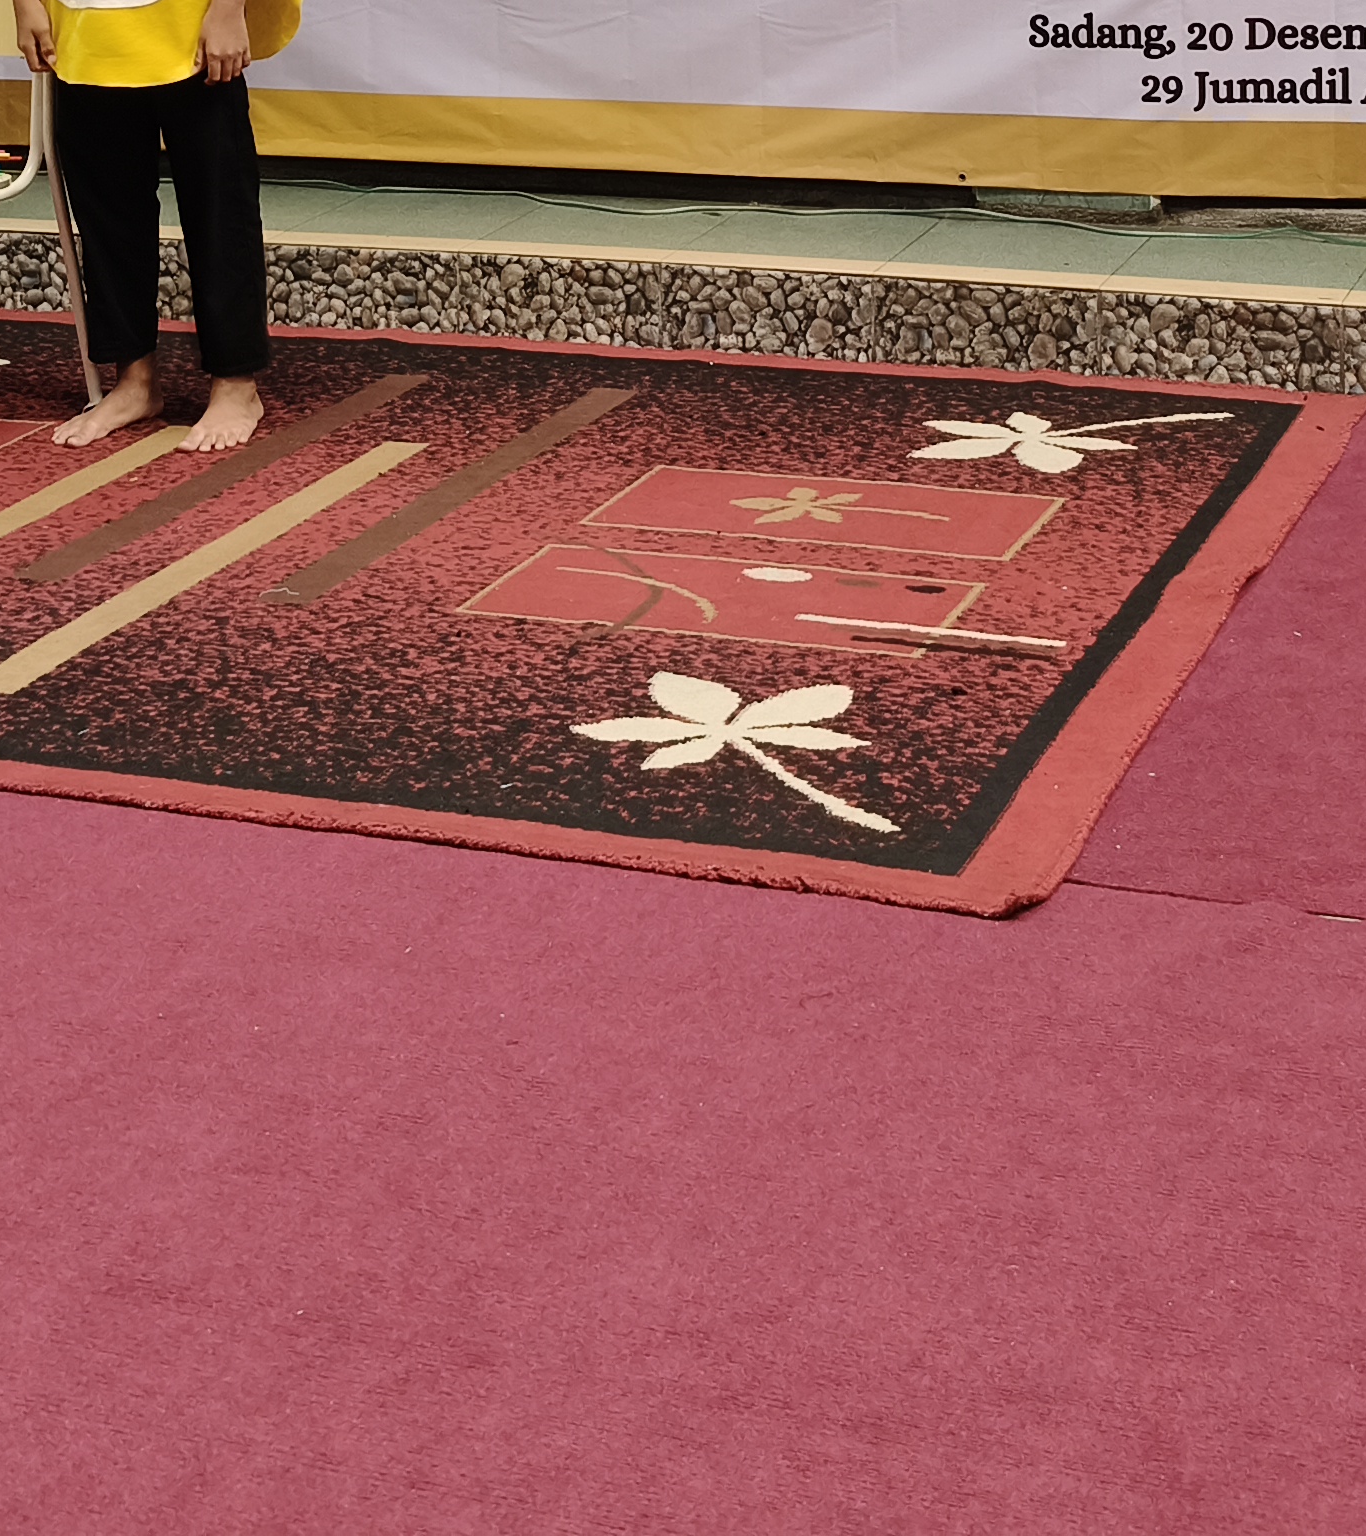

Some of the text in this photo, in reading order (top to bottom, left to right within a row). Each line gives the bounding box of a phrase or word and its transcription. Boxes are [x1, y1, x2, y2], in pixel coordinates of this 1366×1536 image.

[1028, 12, 1176, 60] Sadang,
[1187, 22, 1233, 52] 20
[1141, 74, 1183, 105] 29
[1193, 67, 1351, 113] Jumadil
